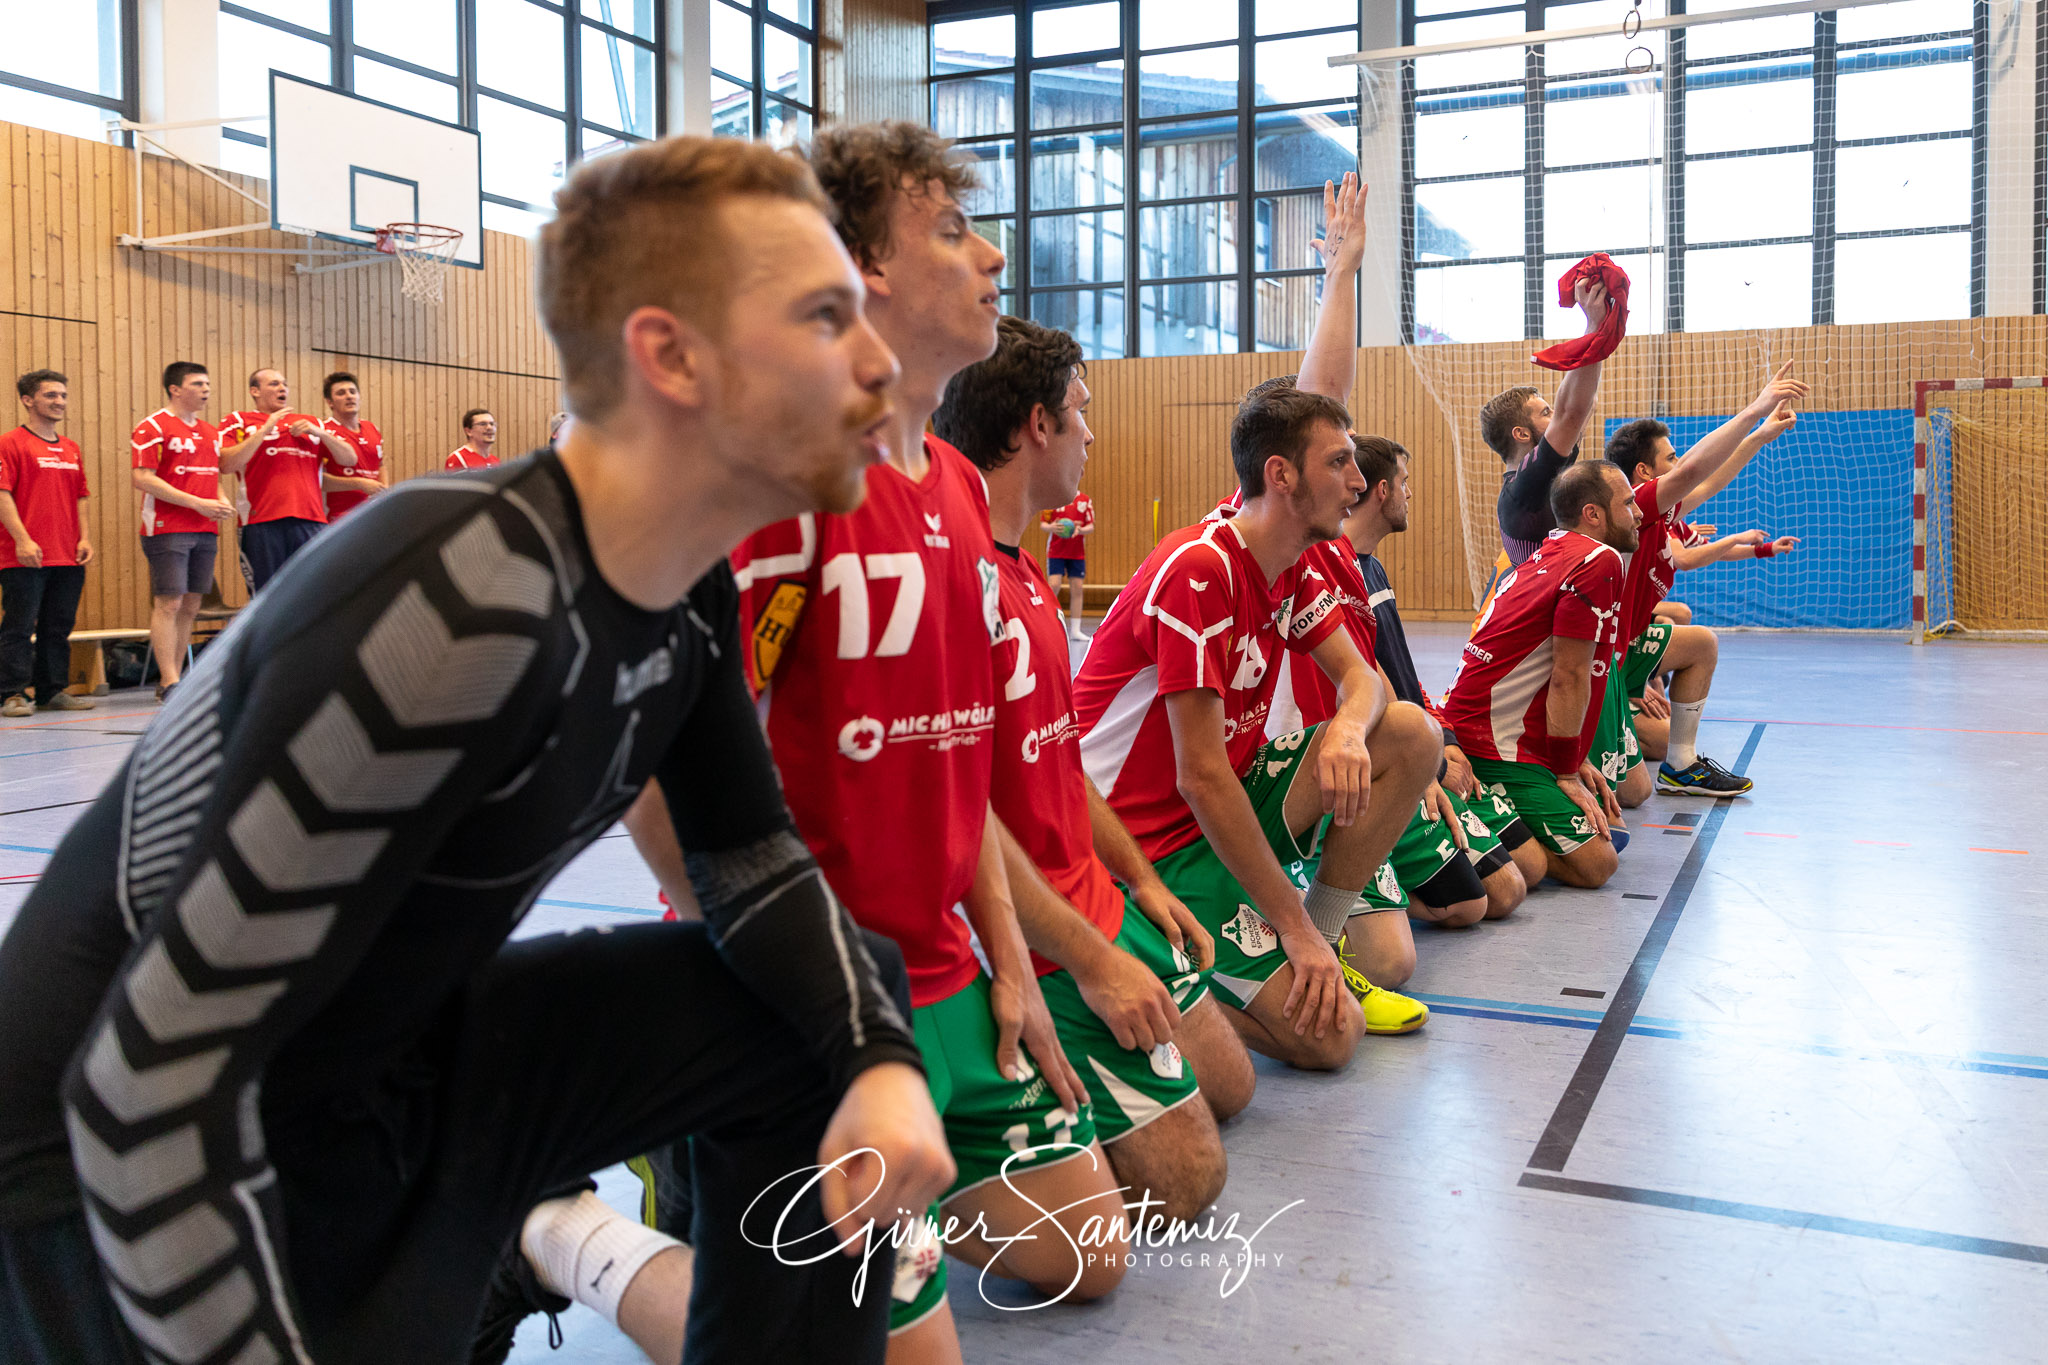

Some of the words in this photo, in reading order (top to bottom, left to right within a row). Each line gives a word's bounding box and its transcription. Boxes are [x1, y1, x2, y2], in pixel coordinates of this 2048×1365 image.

[168, 436, 197, 454] 44
[821, 551, 927, 661] 17
[1290, 611, 1315, 635] TOP
[1319, 593, 1336, 612] FM
[1642, 626, 1665, 655] 33
